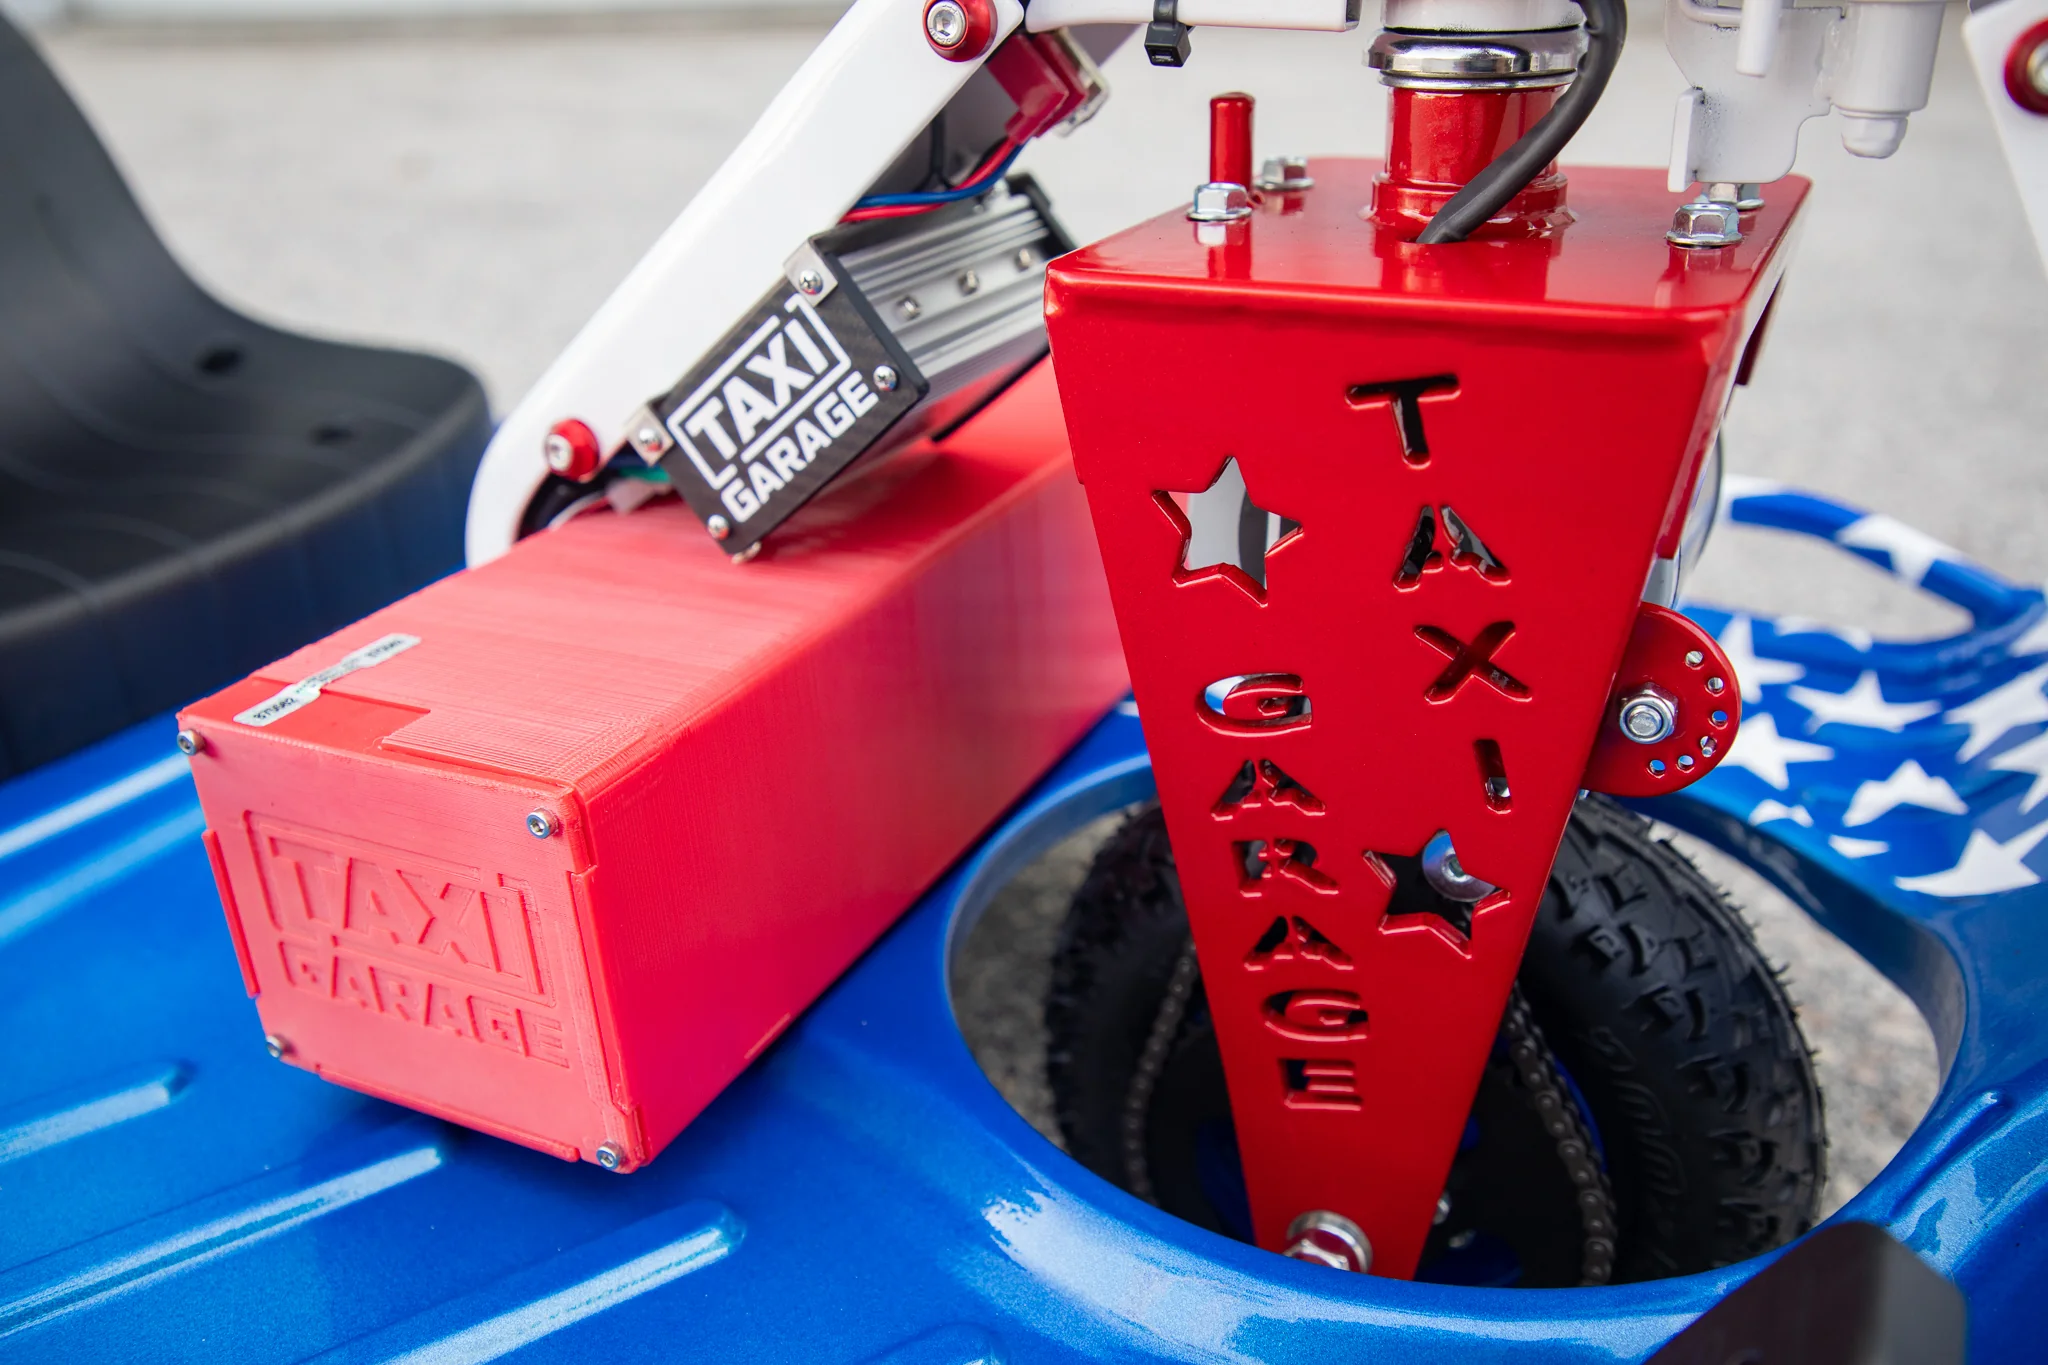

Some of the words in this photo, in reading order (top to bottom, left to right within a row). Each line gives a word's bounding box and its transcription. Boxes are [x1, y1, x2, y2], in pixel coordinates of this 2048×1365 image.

[685, 318, 829, 460] TAXI
[720, 370, 879, 523] GARAGE
[1345, 373, 1532, 814] TAXI
[269, 836, 524, 979] TAXI
[1196, 672, 1370, 1111] GARAGE
[278, 940, 570, 1069] GARAGE
